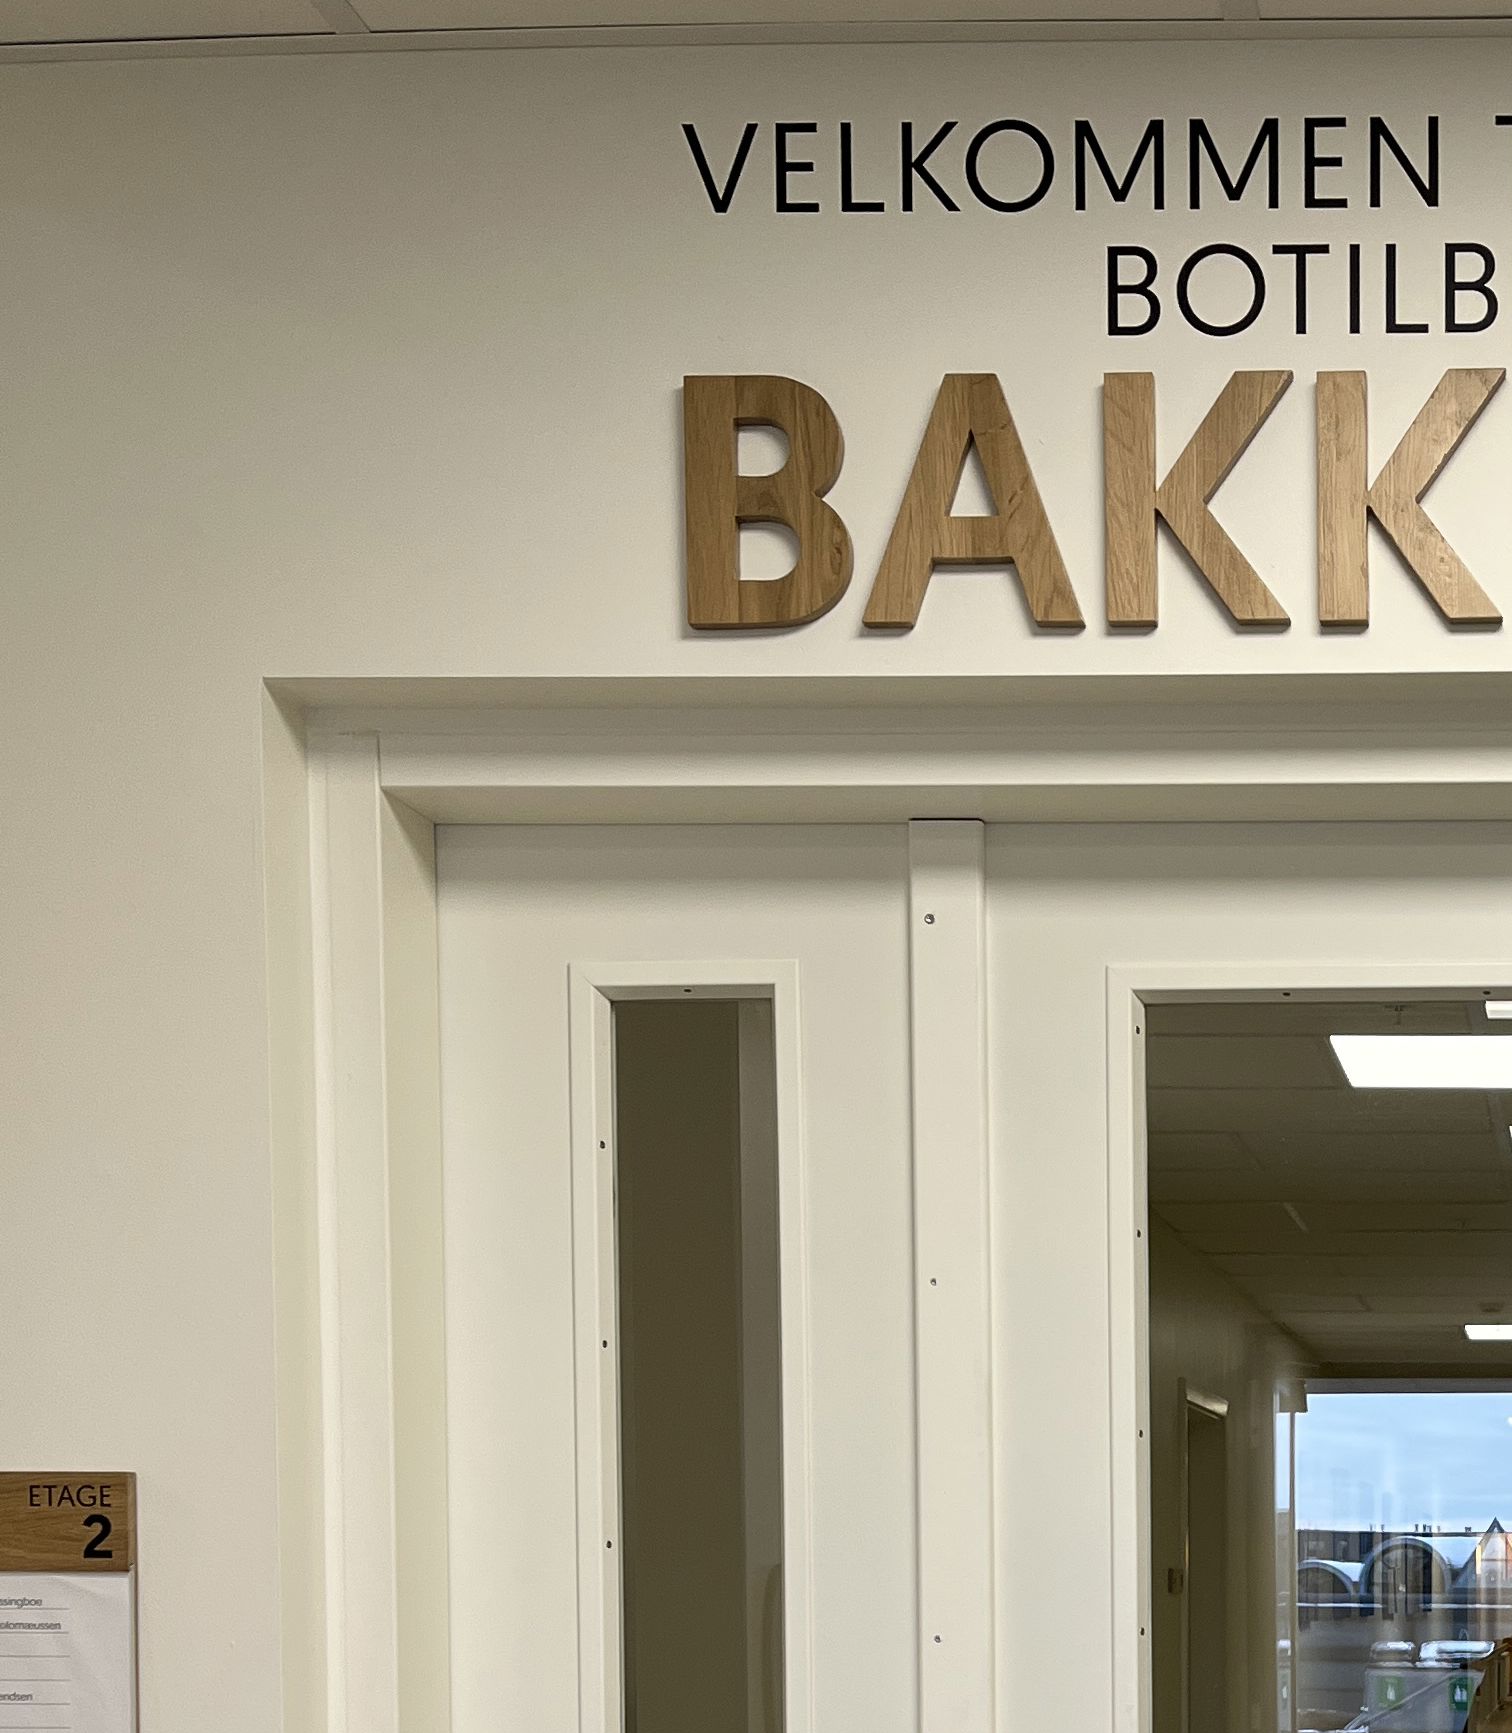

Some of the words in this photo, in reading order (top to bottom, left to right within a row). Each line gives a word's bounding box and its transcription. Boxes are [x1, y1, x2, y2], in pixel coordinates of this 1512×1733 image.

[681, 115, 1439, 214] VELKOMMEN
[27, 1484, 112, 1508] ETAGE
[82, 1513, 113, 1559] 2
